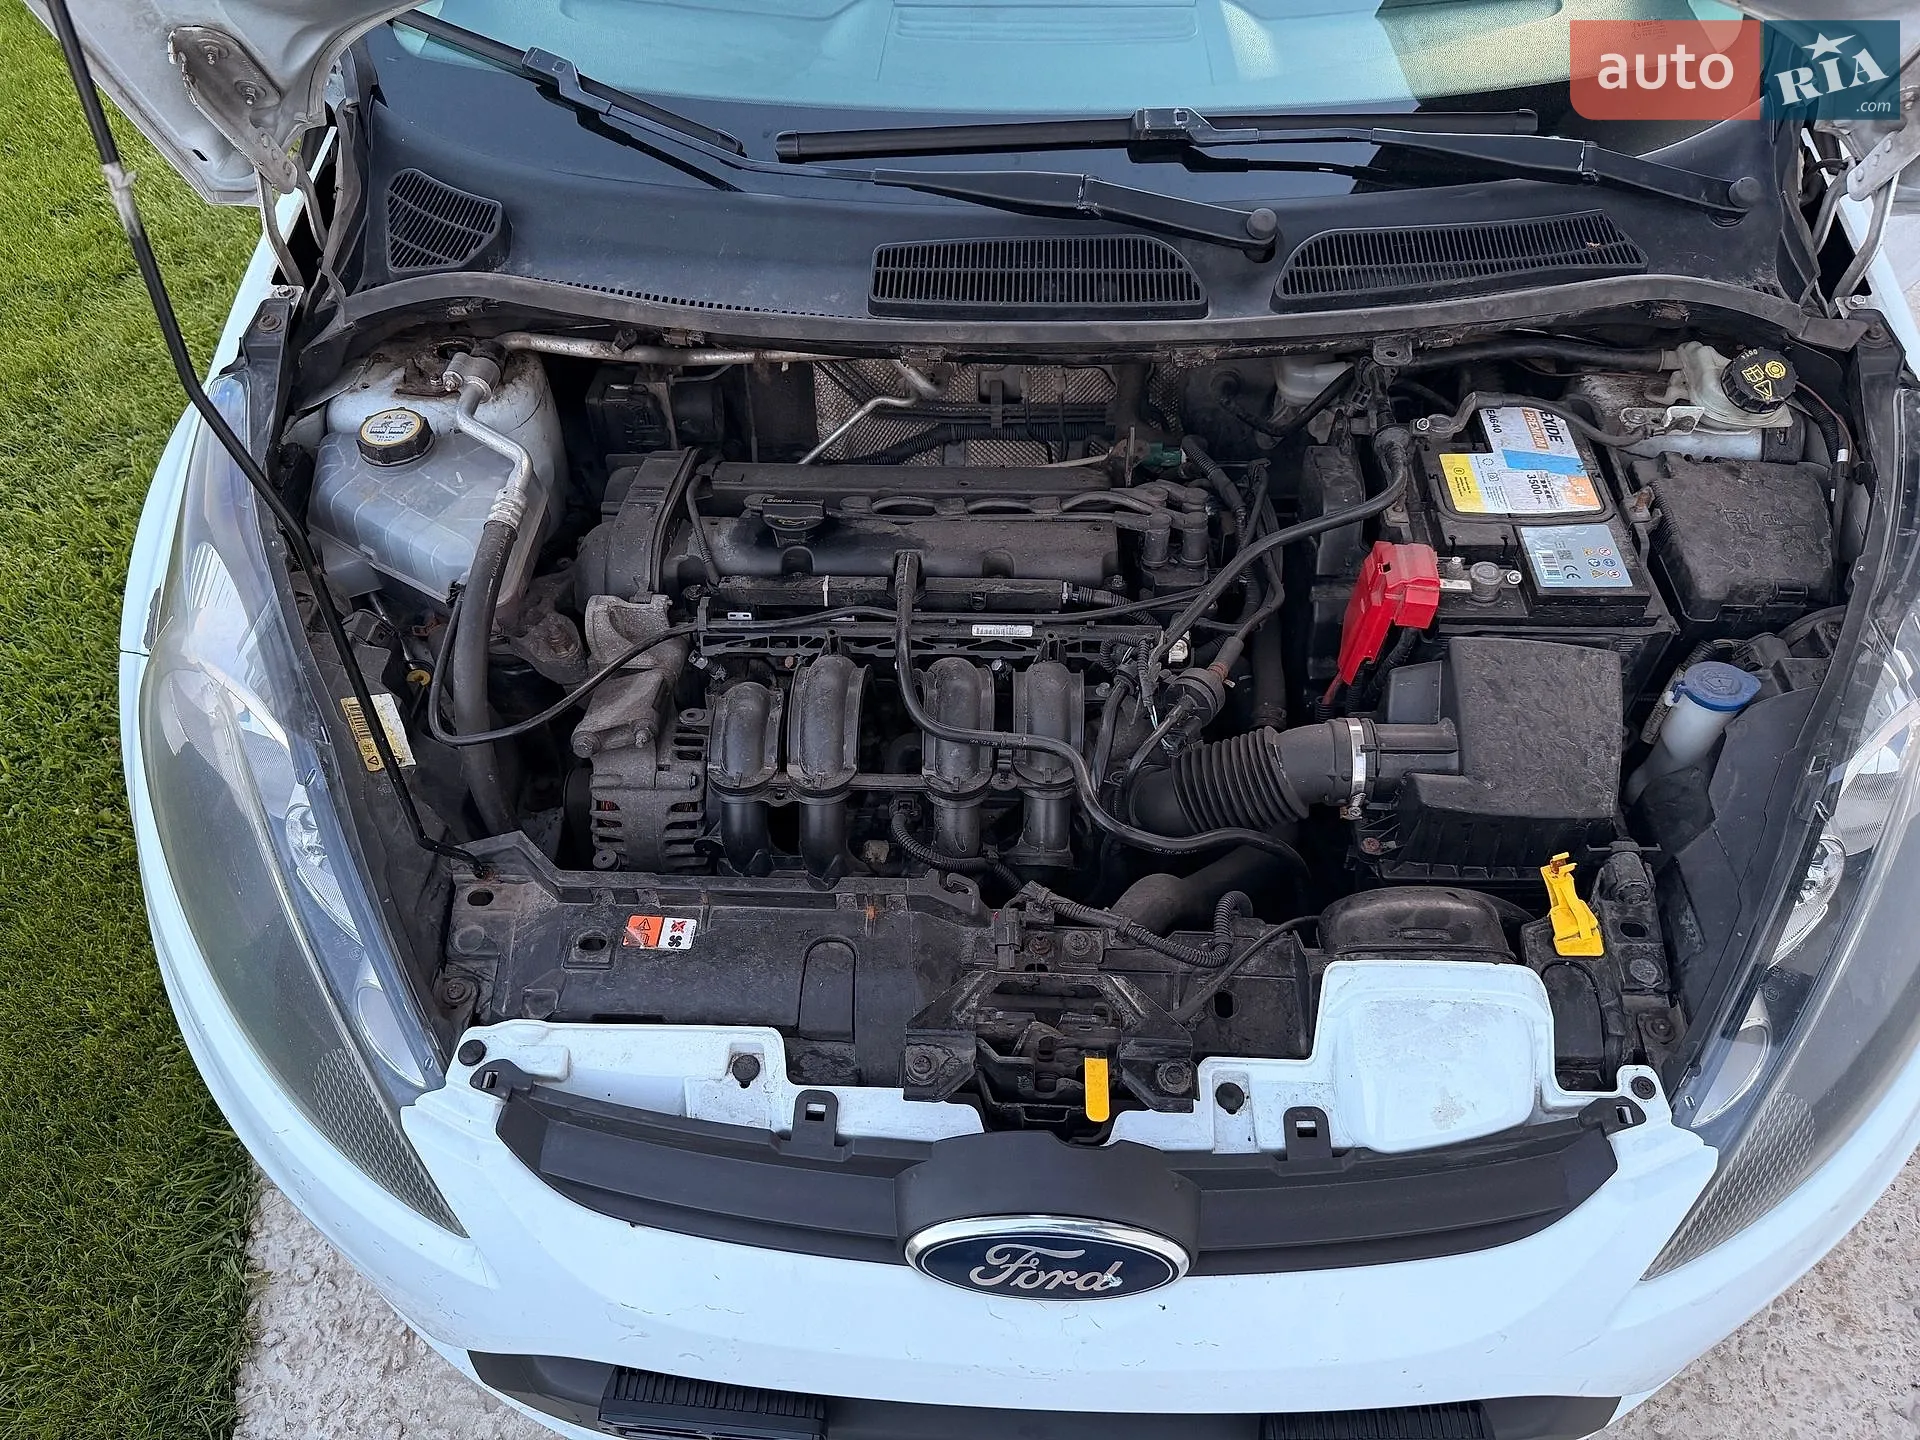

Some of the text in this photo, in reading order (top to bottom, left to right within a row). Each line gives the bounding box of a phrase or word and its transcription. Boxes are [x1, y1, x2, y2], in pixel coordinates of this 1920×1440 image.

[1486, 409, 1502, 433] EA640
[1523, 410, 1547, 448] PREMIUM
[1540, 411, 1564, 443] EXIDE
[1526, 474, 1543, 495] 3500
[969, 1243, 1124, 1291] Ford
